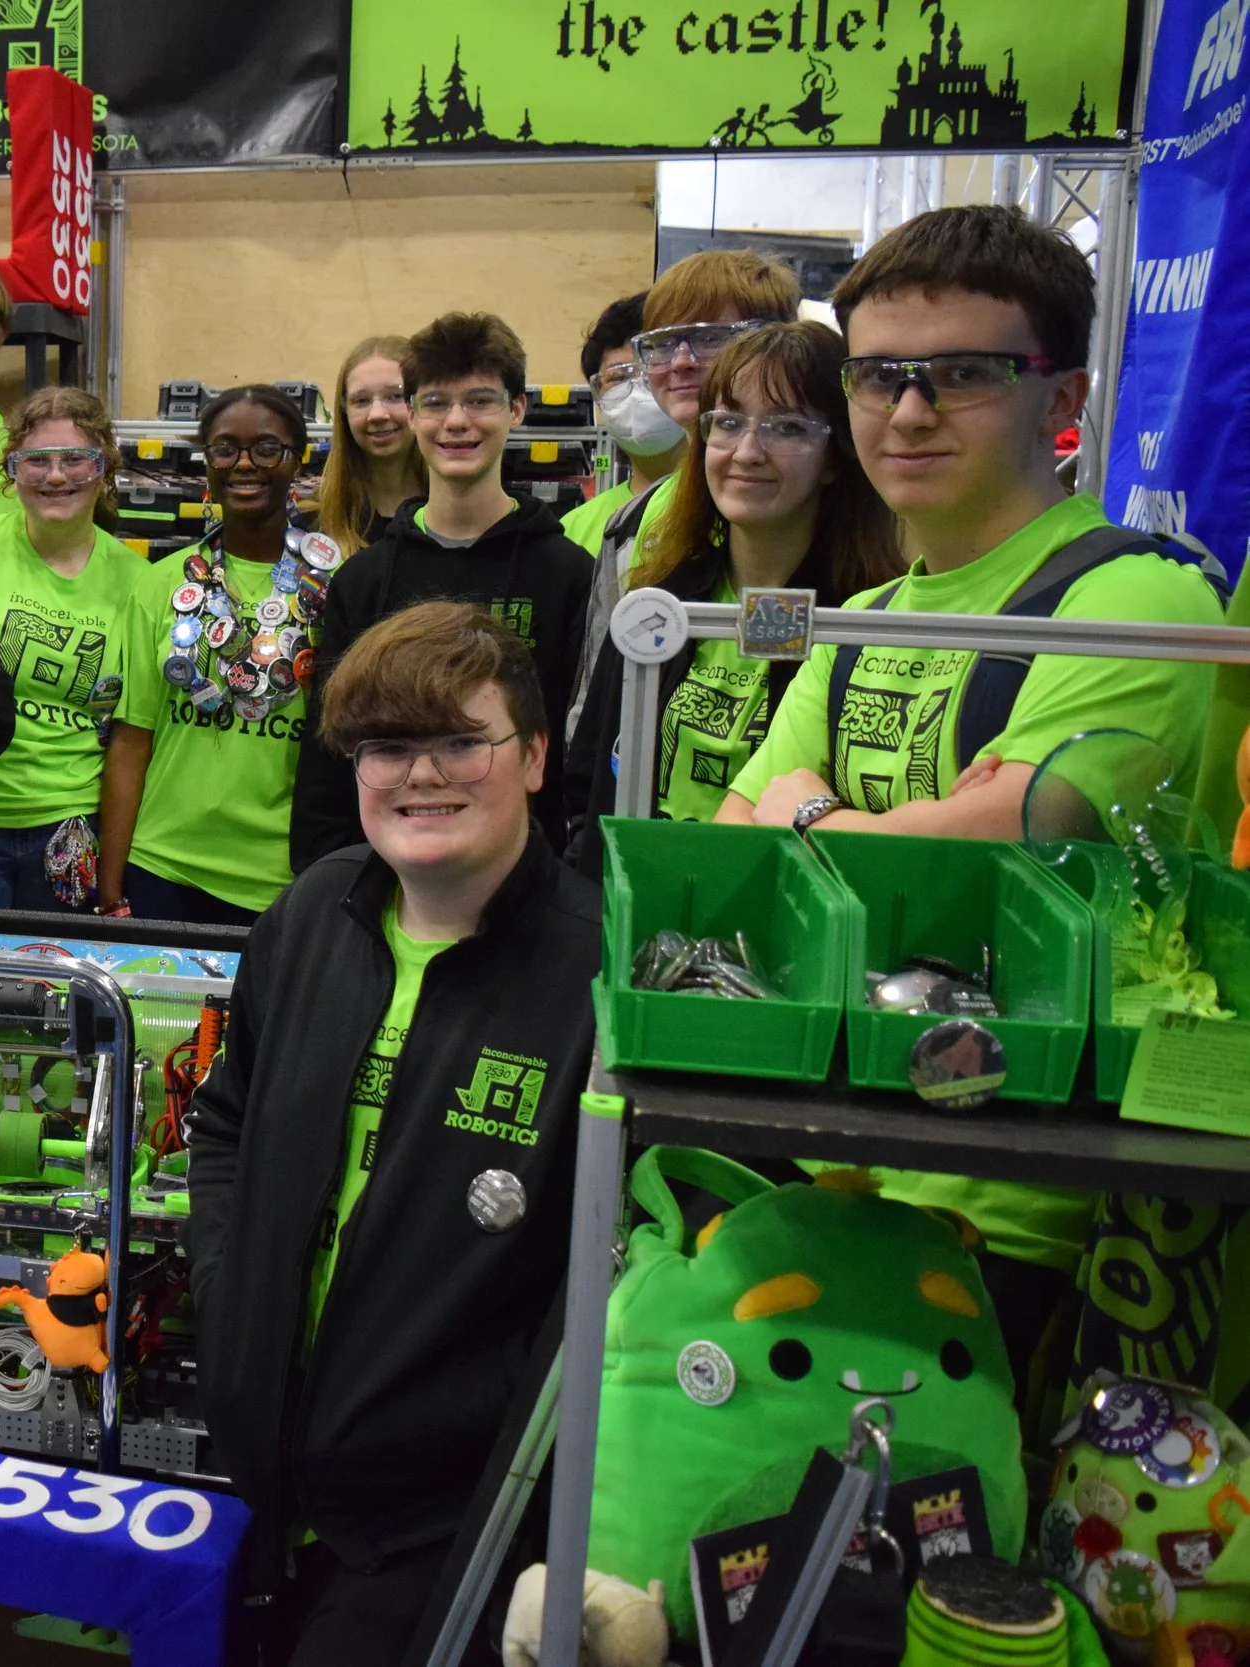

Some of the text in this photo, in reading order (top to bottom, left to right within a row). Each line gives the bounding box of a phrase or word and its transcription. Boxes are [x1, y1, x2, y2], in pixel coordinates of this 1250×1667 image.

[557, 0, 889, 72] the castle!
[52, 129, 71, 300] 2530
[75, 147, 92, 308] 2530
[596, 457, 610, 468] B1
[15, 617, 58, 642] 2530
[667, 689, 730, 728] 2530
[838, 702, 900, 736] 2530
[480, 1045, 549, 1071] inconceivable
[443, 1108, 540, 1147] ROBOTICS
